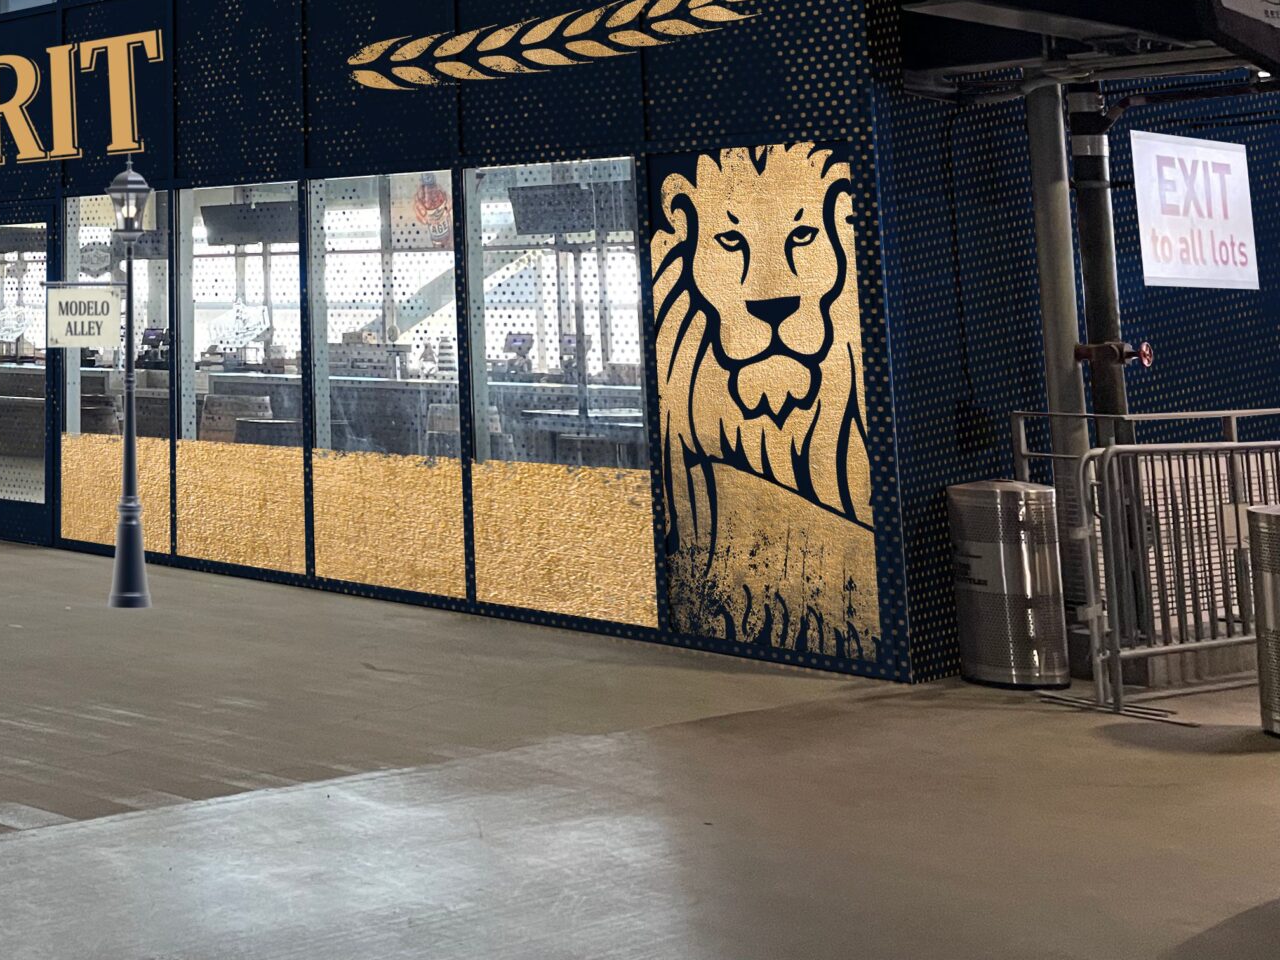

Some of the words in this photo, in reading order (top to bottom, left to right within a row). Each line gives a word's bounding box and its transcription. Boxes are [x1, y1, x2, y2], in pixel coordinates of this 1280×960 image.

[1155, 154, 1232, 220] EXIT
[1150, 227, 1174, 263] to
[1178, 228, 1207, 266] all
[1209, 230, 1249, 267] lots
[58, 300, 110, 316] MODELO
[65, 320, 103, 336] ALLEY
